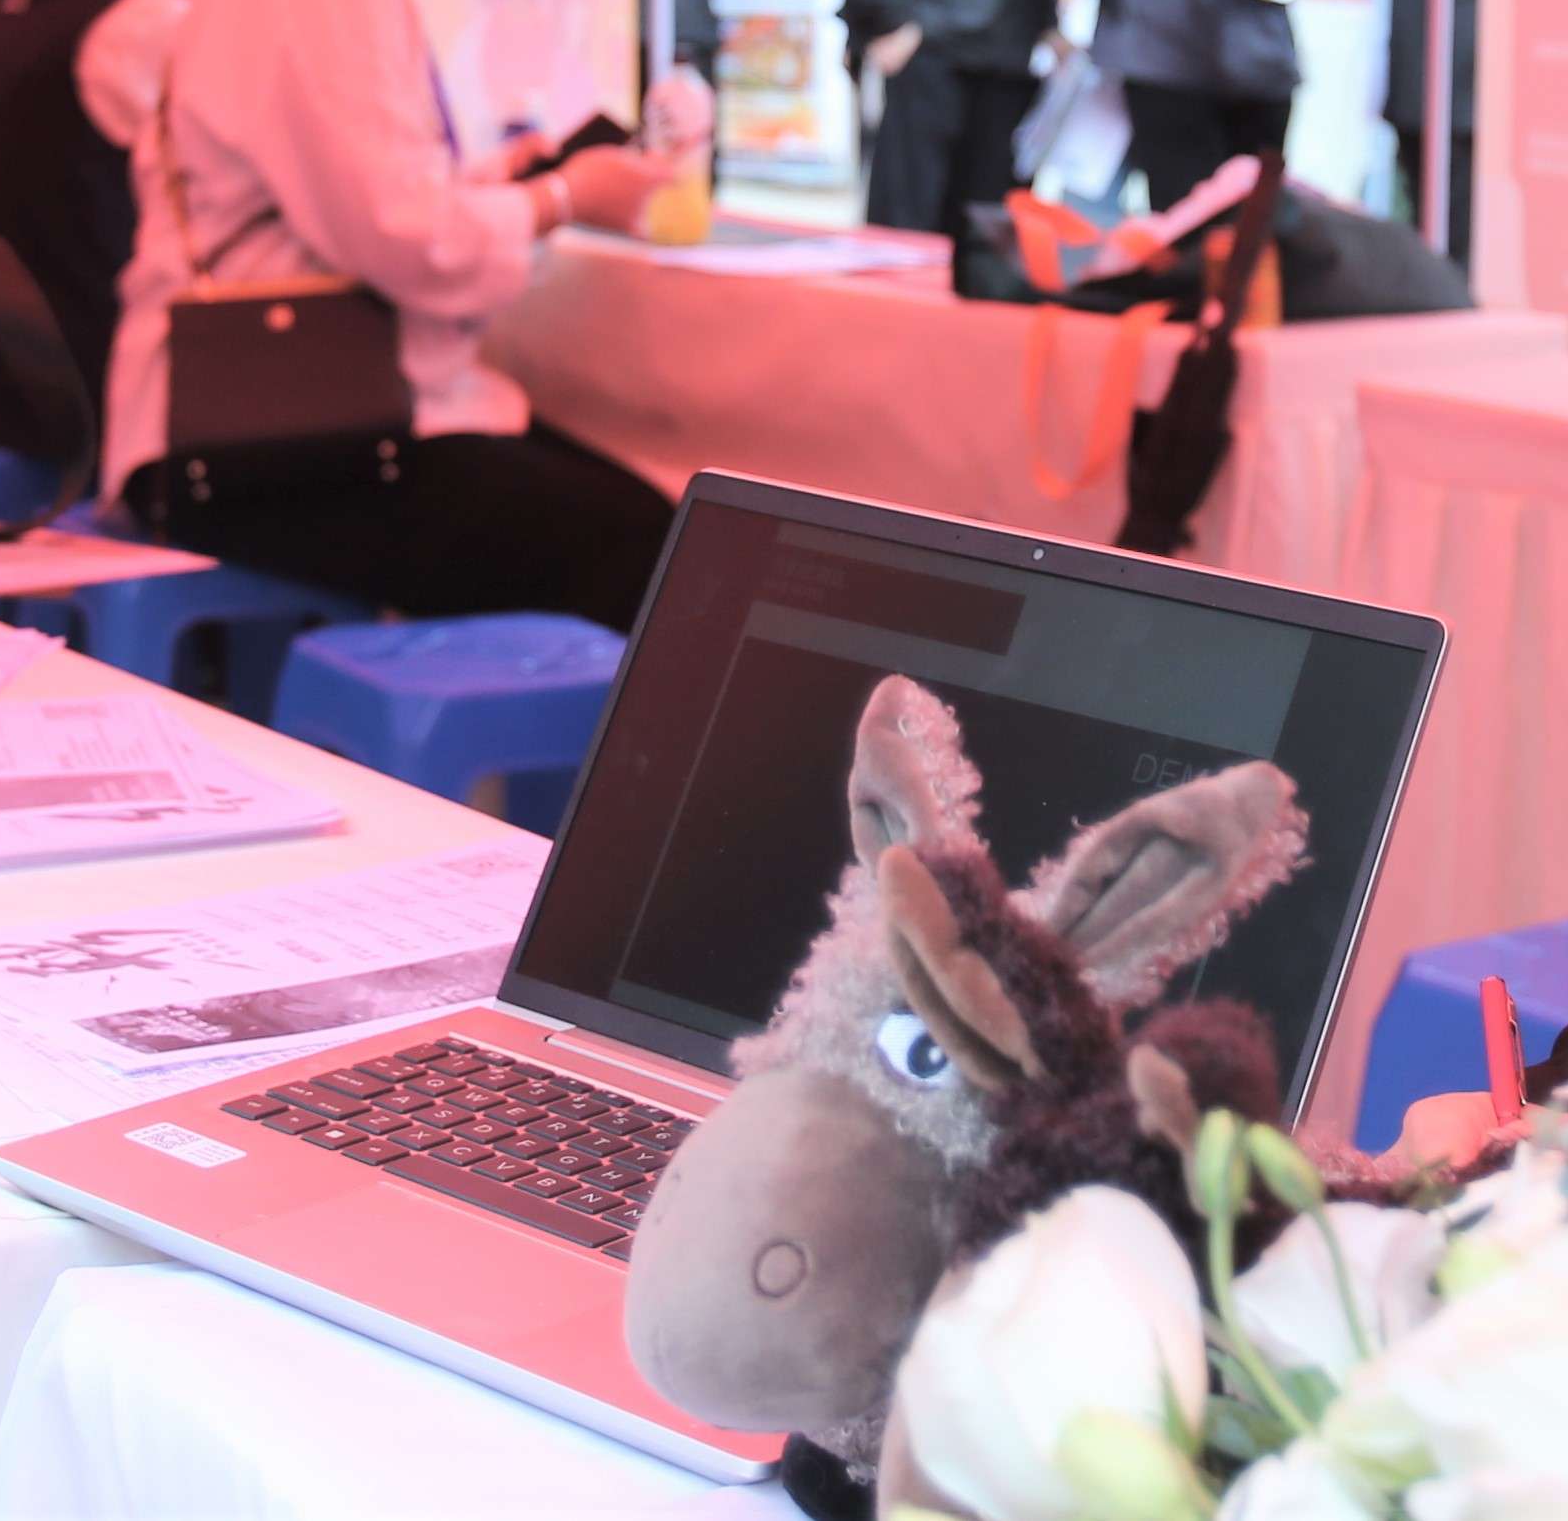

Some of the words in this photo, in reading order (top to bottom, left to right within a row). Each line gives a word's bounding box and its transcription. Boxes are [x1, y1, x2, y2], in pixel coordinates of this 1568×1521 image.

[369, 1115, 390, 1125] Z
[409, 1130, 431, 1140] X
[452, 1146, 472, 1155] C
[497, 1161, 516, 1171] V
[536, 1177, 557, 1187] B
[580, 1192, 603, 1203] N
[392, 1095, 410, 1104] A
[434, 1109, 453, 1119] S
[473, 1124, 493, 1133] D
[516, 1139, 536, 1148] F
[559, 1155, 579, 1165] G
[601, 1170, 623, 1180] H
[426, 1078, 445, 1087] Q
[465, 1091, 489, 1102] W
[506, 1107, 526, 1117] E
[547, 1121, 567, 1131] R
[593, 1137, 611, 1146] T
[636, 1152, 654, 1161] Y
